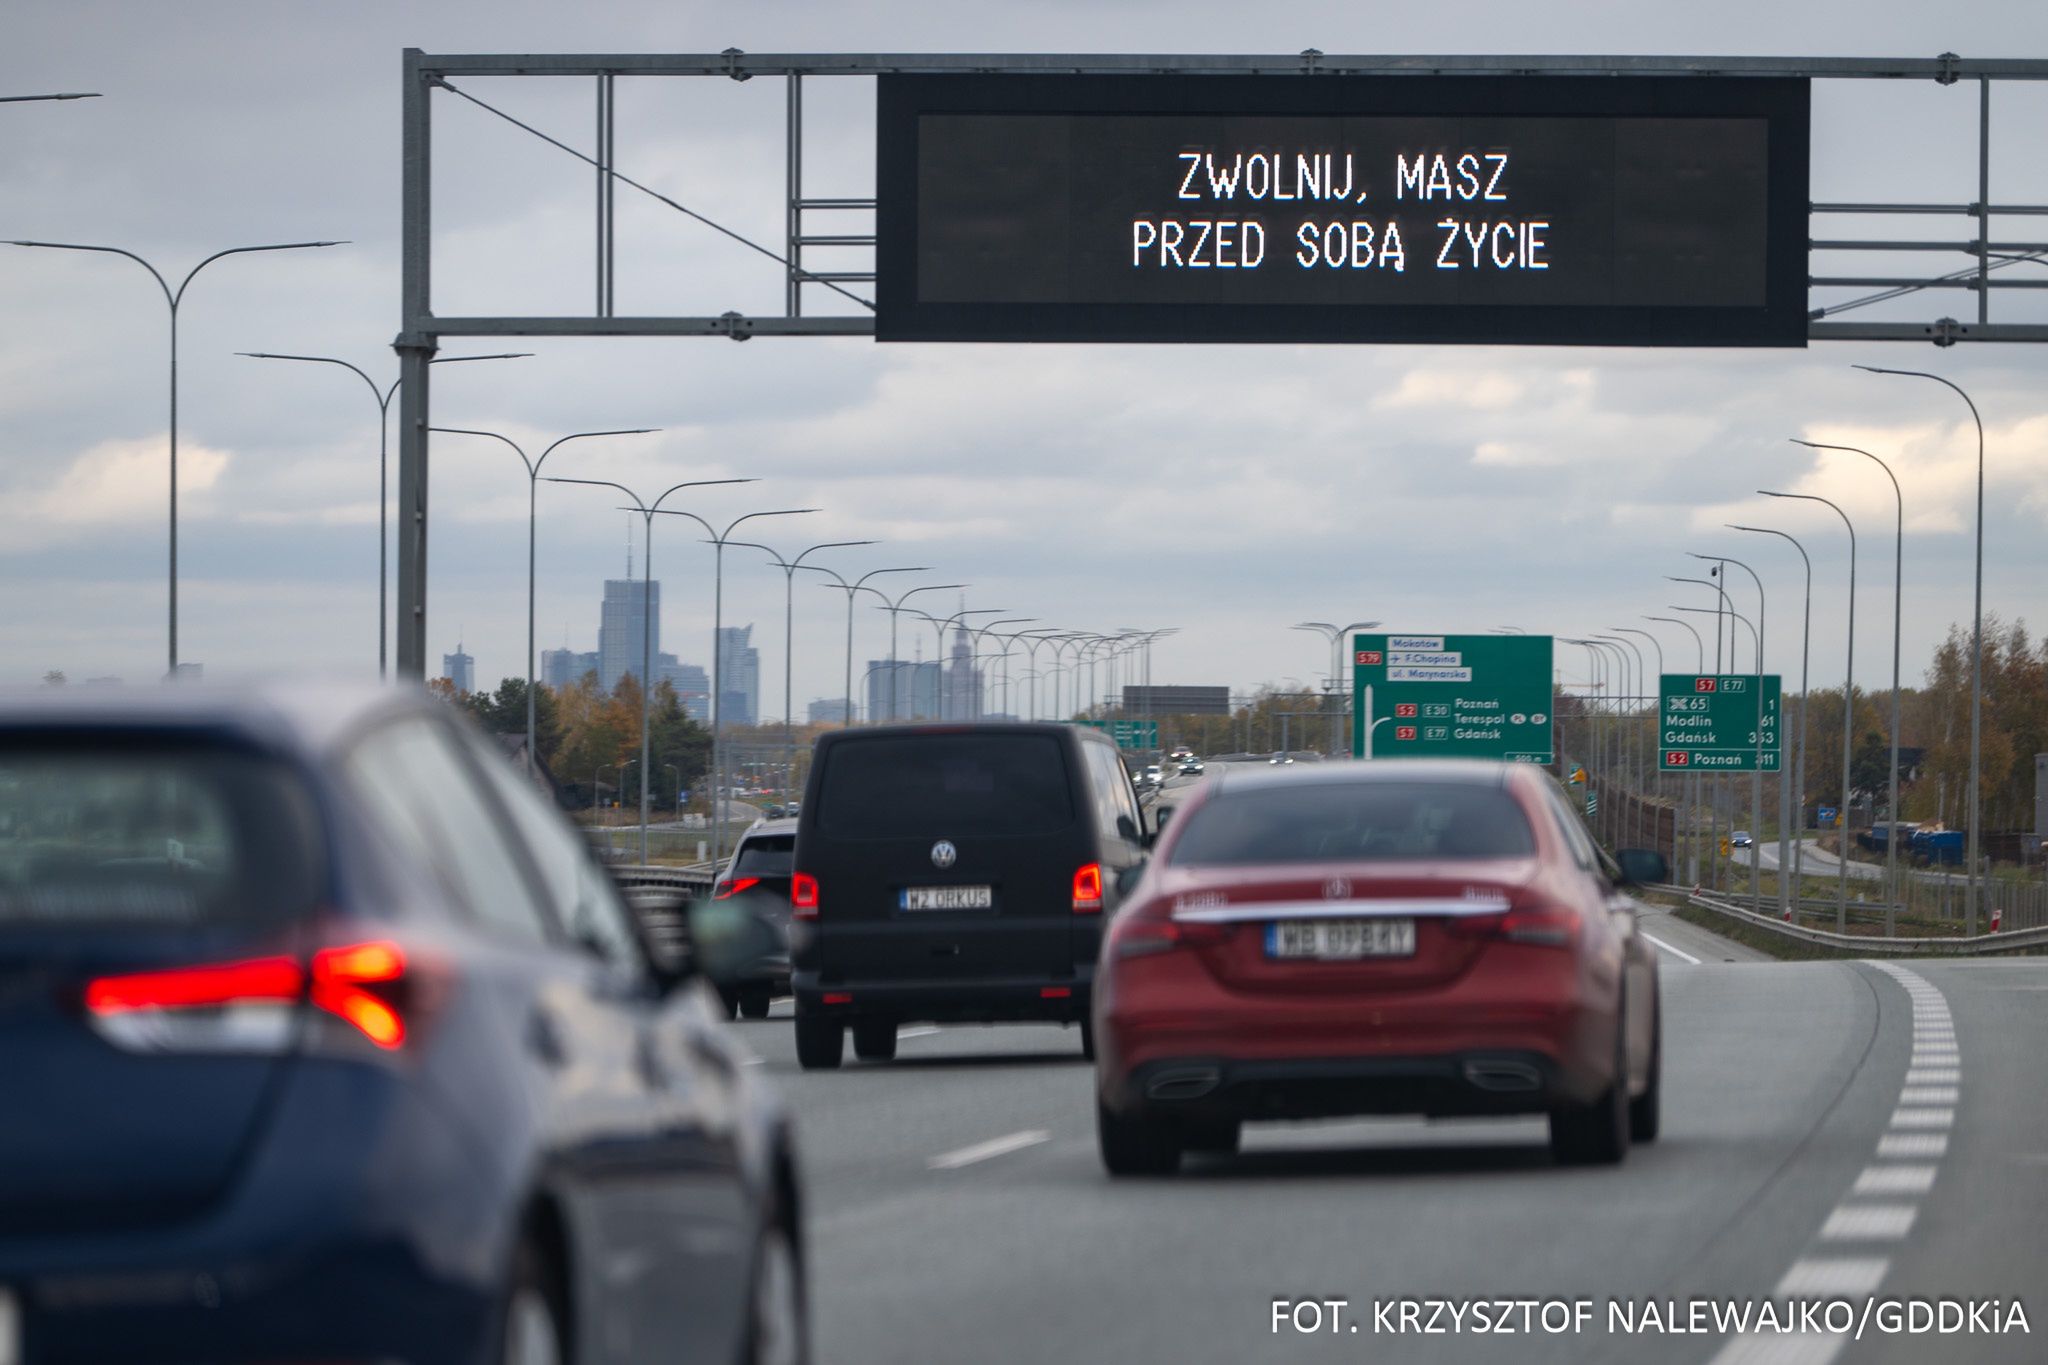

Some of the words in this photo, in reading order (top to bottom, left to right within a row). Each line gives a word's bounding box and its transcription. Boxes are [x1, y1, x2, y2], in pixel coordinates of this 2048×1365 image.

[1178, 153, 1367, 204] ZWOLNIJ,
[1397, 153, 1507, 200] MASZ
[1132, 220, 1265, 268] PRZED
[1297, 220, 1405, 272] SOBĄ
[1437, 217, 1549, 268] ŻYCIE
[1409, 669, 1467, 680] Marynarska
[1455, 698, 1499, 709] Poznań
[1690, 698, 1707, 710] 65
[1768, 699, 1775, 711] 1
[1454, 713, 1505, 726] Terespol
[1665, 715, 1712, 727] Modlin
[1760, 715, 1775, 727] 61
[1454, 728, 1501, 739] Gdańsk
[1665, 732, 1717, 743] Gdańsk
[1694, 753, 1742, 765] Poznań
